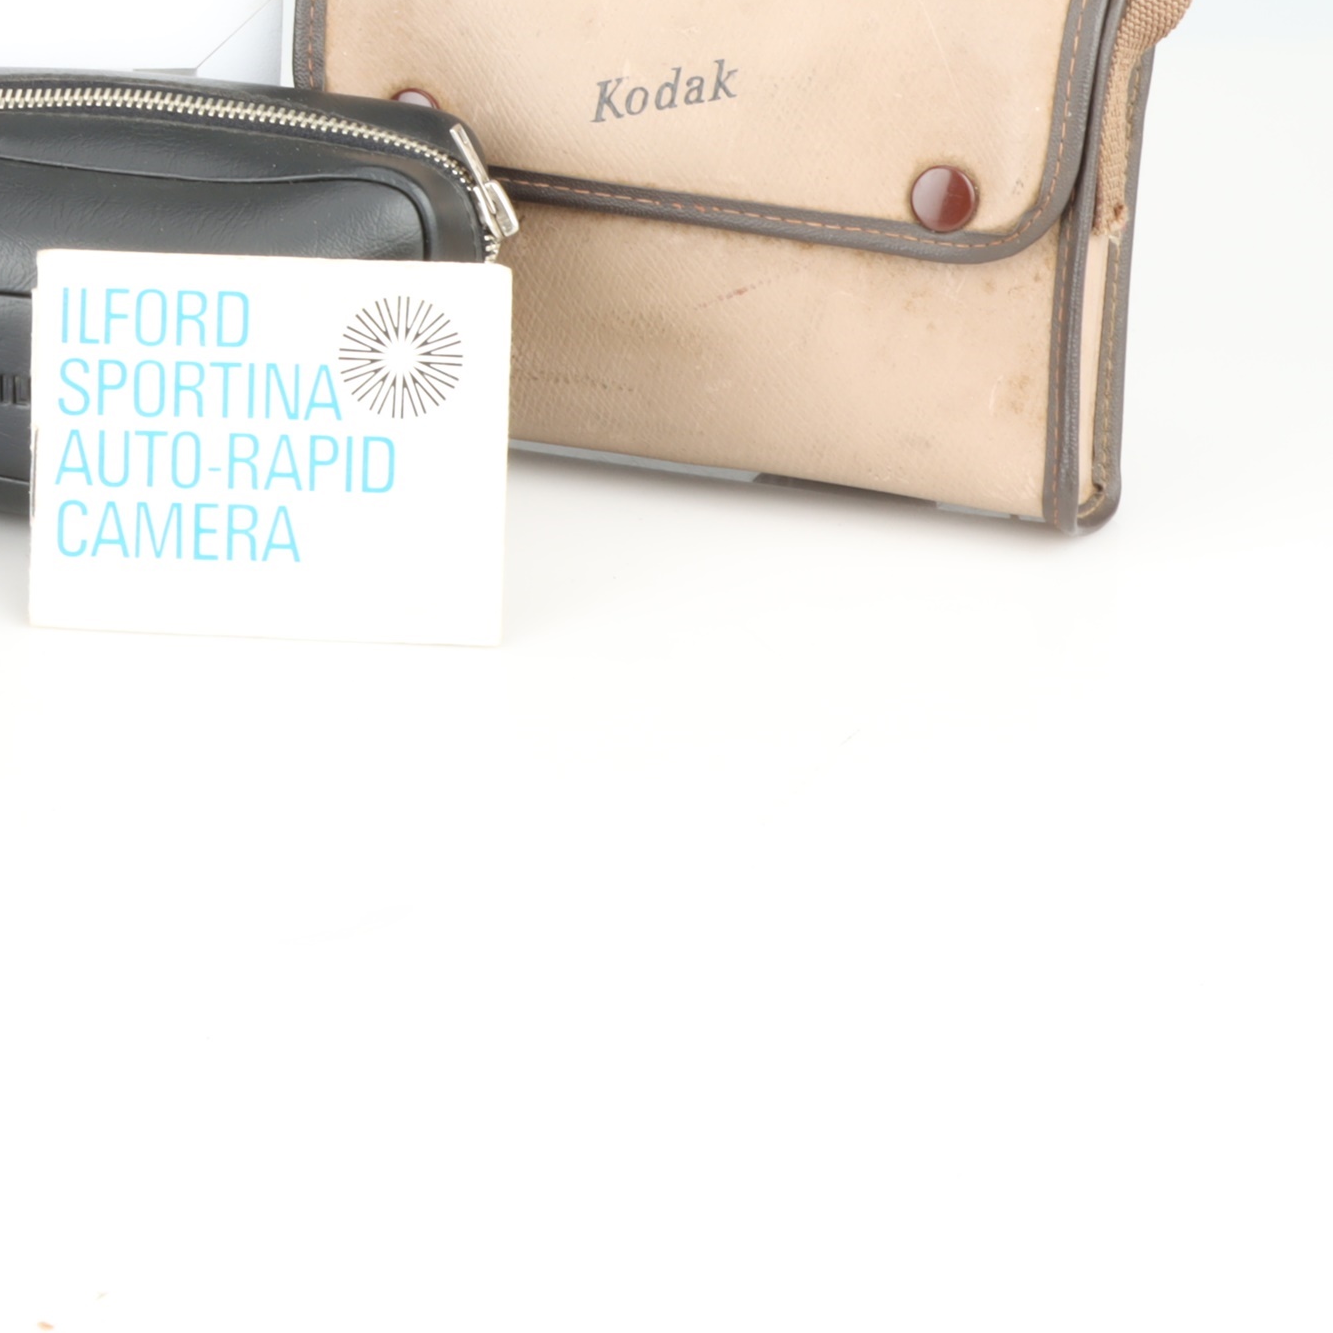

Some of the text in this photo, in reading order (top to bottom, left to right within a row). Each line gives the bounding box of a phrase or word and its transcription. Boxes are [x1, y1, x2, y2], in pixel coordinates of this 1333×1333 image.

[590, 58, 739, 123] Kodak
[61, 287, 250, 348] ILFORD
[58, 357, 342, 421] SPORTINA
[55, 428, 396, 494] AUTO-RAPID
[56, 499, 301, 563] CAMERA
